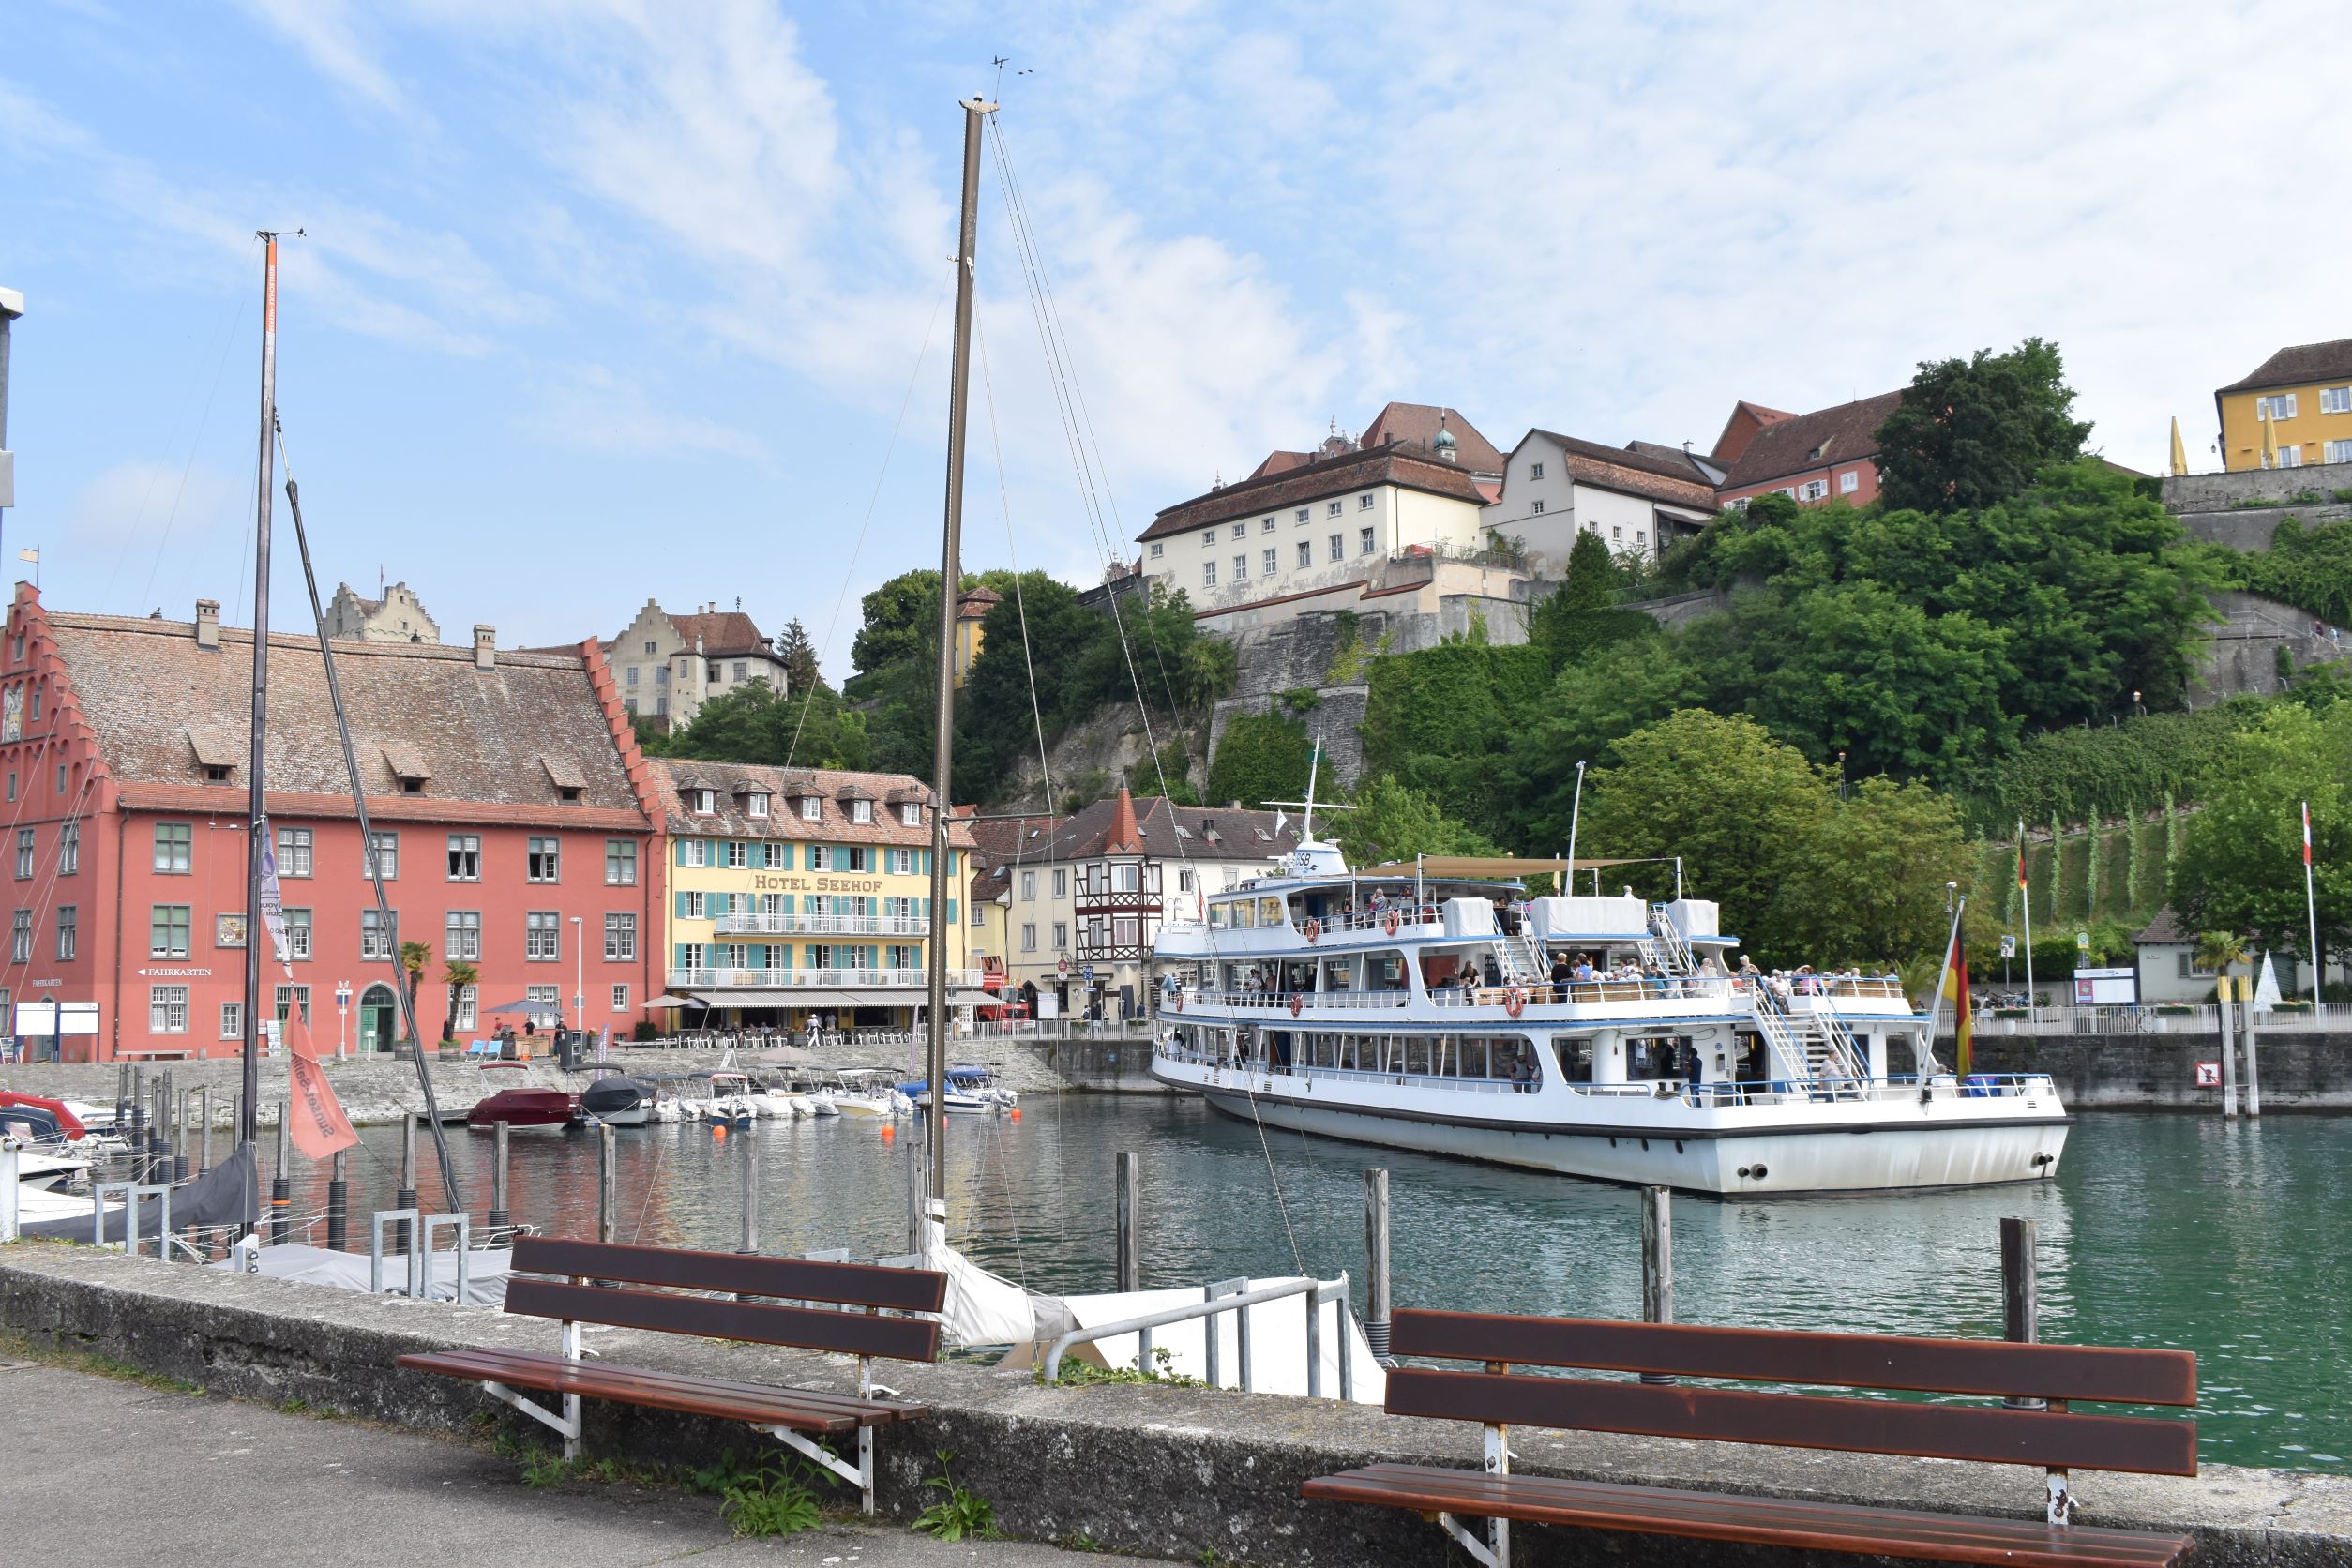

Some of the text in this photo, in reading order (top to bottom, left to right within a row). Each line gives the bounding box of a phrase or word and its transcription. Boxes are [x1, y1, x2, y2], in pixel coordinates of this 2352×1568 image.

[1296, 853, 1311, 866] BSB
[755, 875, 882, 892] HOTEL SEEHOF
[148, 968, 211, 977] FAHRKARTEN
[32, 978, 62, 988] FAHRKARTEN
